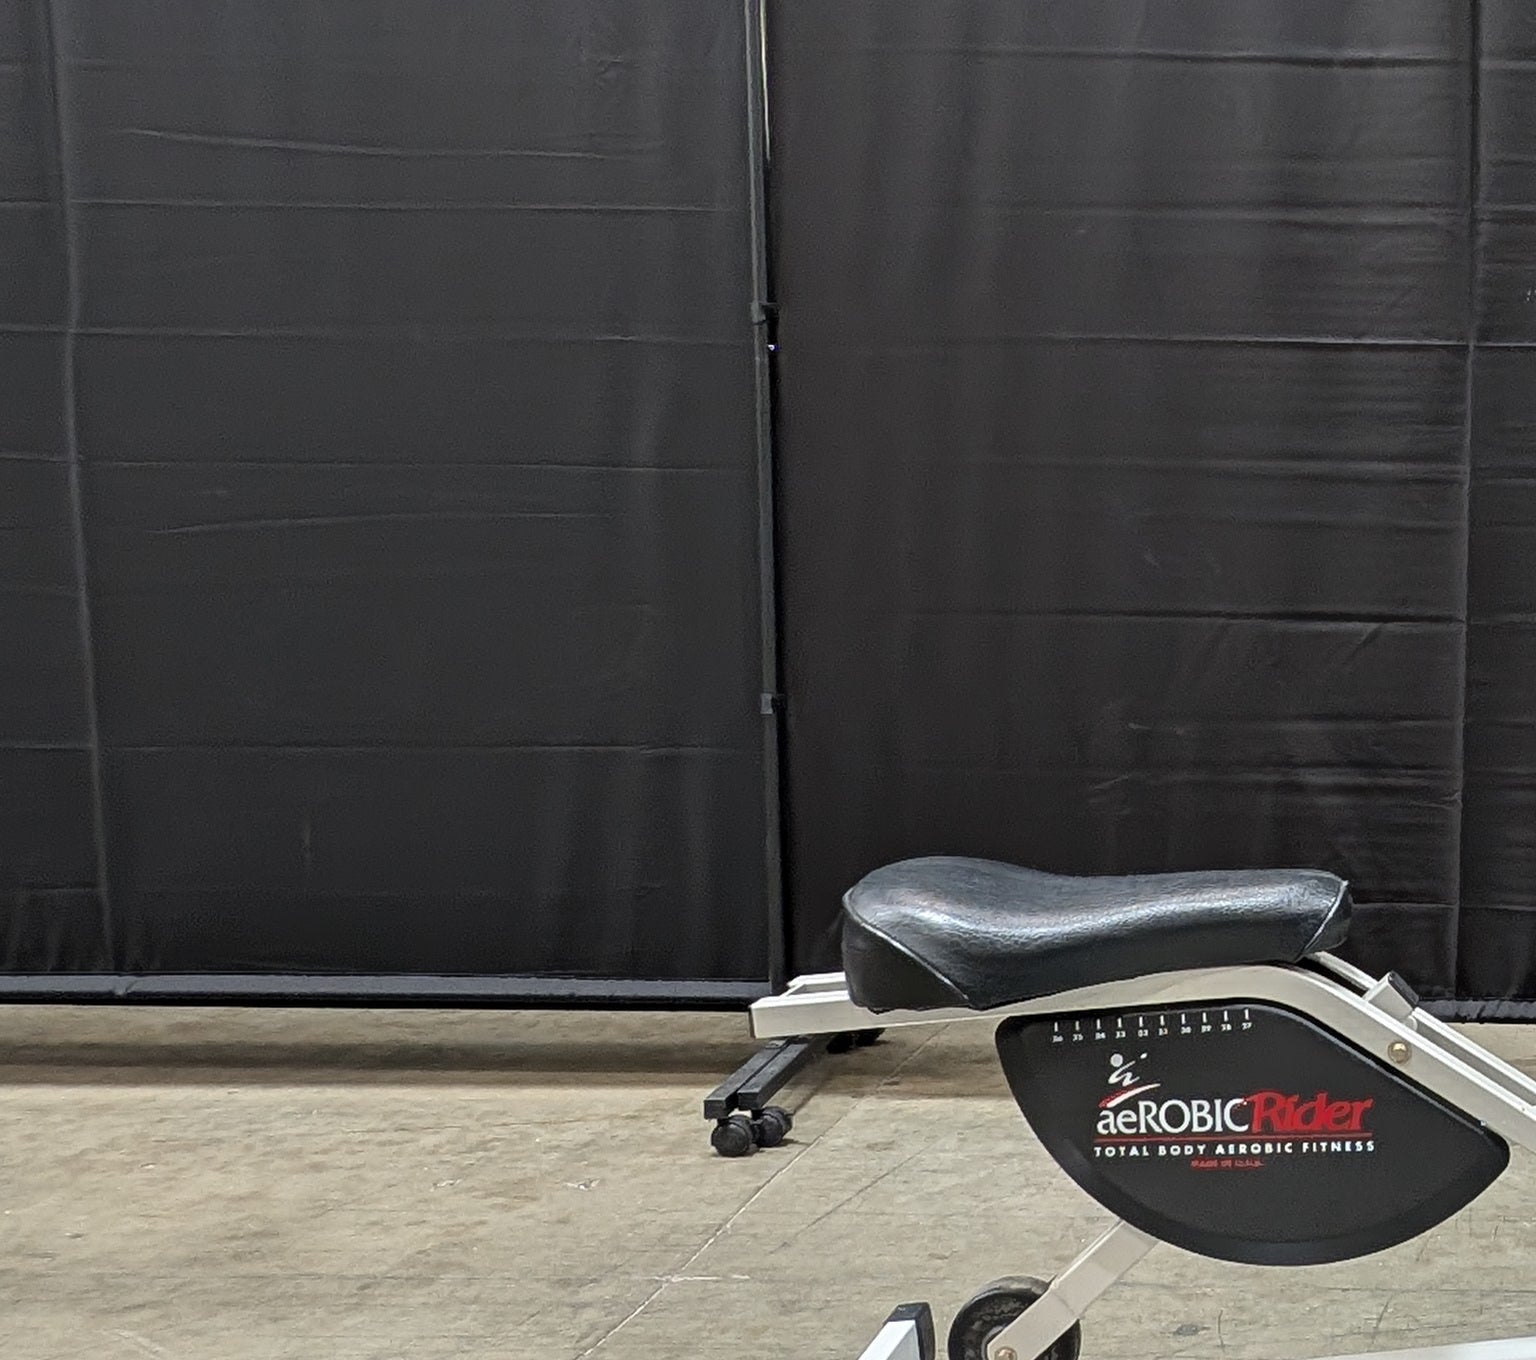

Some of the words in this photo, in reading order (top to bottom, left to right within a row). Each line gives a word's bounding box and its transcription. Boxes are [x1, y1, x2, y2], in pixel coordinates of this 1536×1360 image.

[1096, 1098, 1249, 1135] aeROBIC
[1246, 1090, 1374, 1134] Rider
[1093, 1144, 1150, 1158] TOTAL
[1157, 1143, 1207, 1157] BODY
[1214, 1141, 1294, 1156] AEROBIC
[1301, 1139, 1376, 1154] FITNESS
